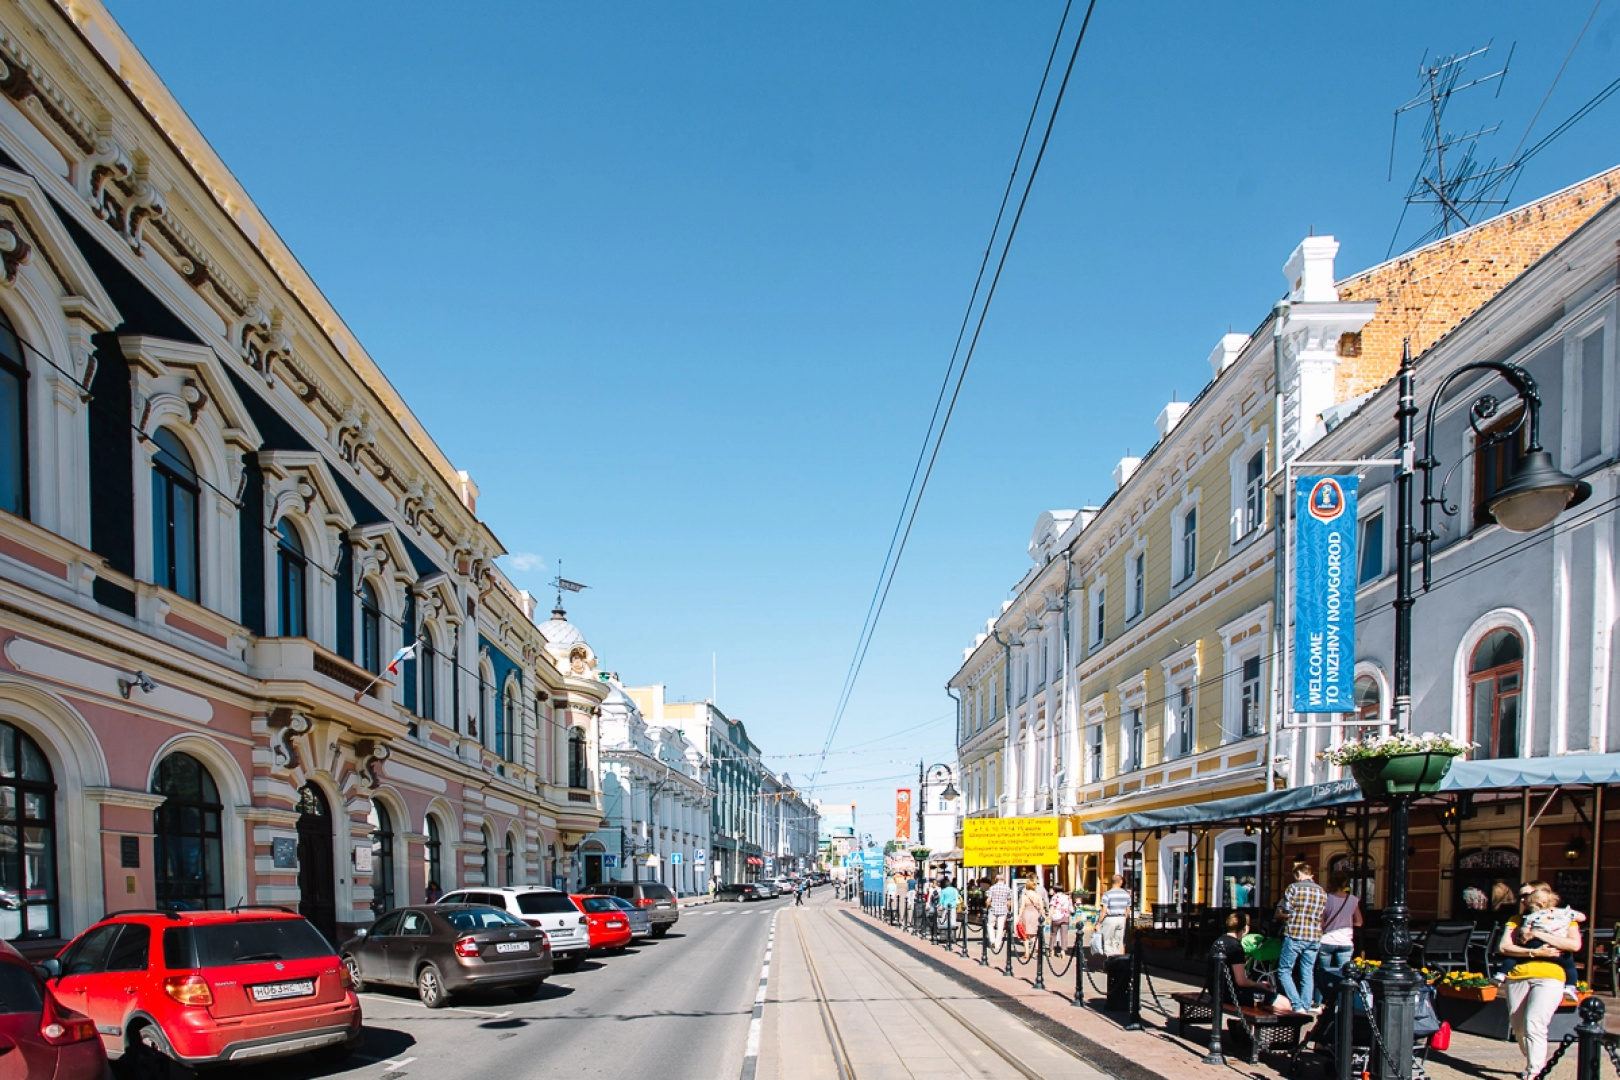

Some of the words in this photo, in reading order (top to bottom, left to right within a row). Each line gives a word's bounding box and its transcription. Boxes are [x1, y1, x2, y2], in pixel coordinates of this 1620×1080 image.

[1327, 531, 1341, 621] NOVGOROD
[1309, 632, 1323, 706] WELCOME
[1326, 624, 1340, 682] NIZHNY
[1326, 685, 1339, 706] TO
[1312, 784, 1331, 797] Паб
